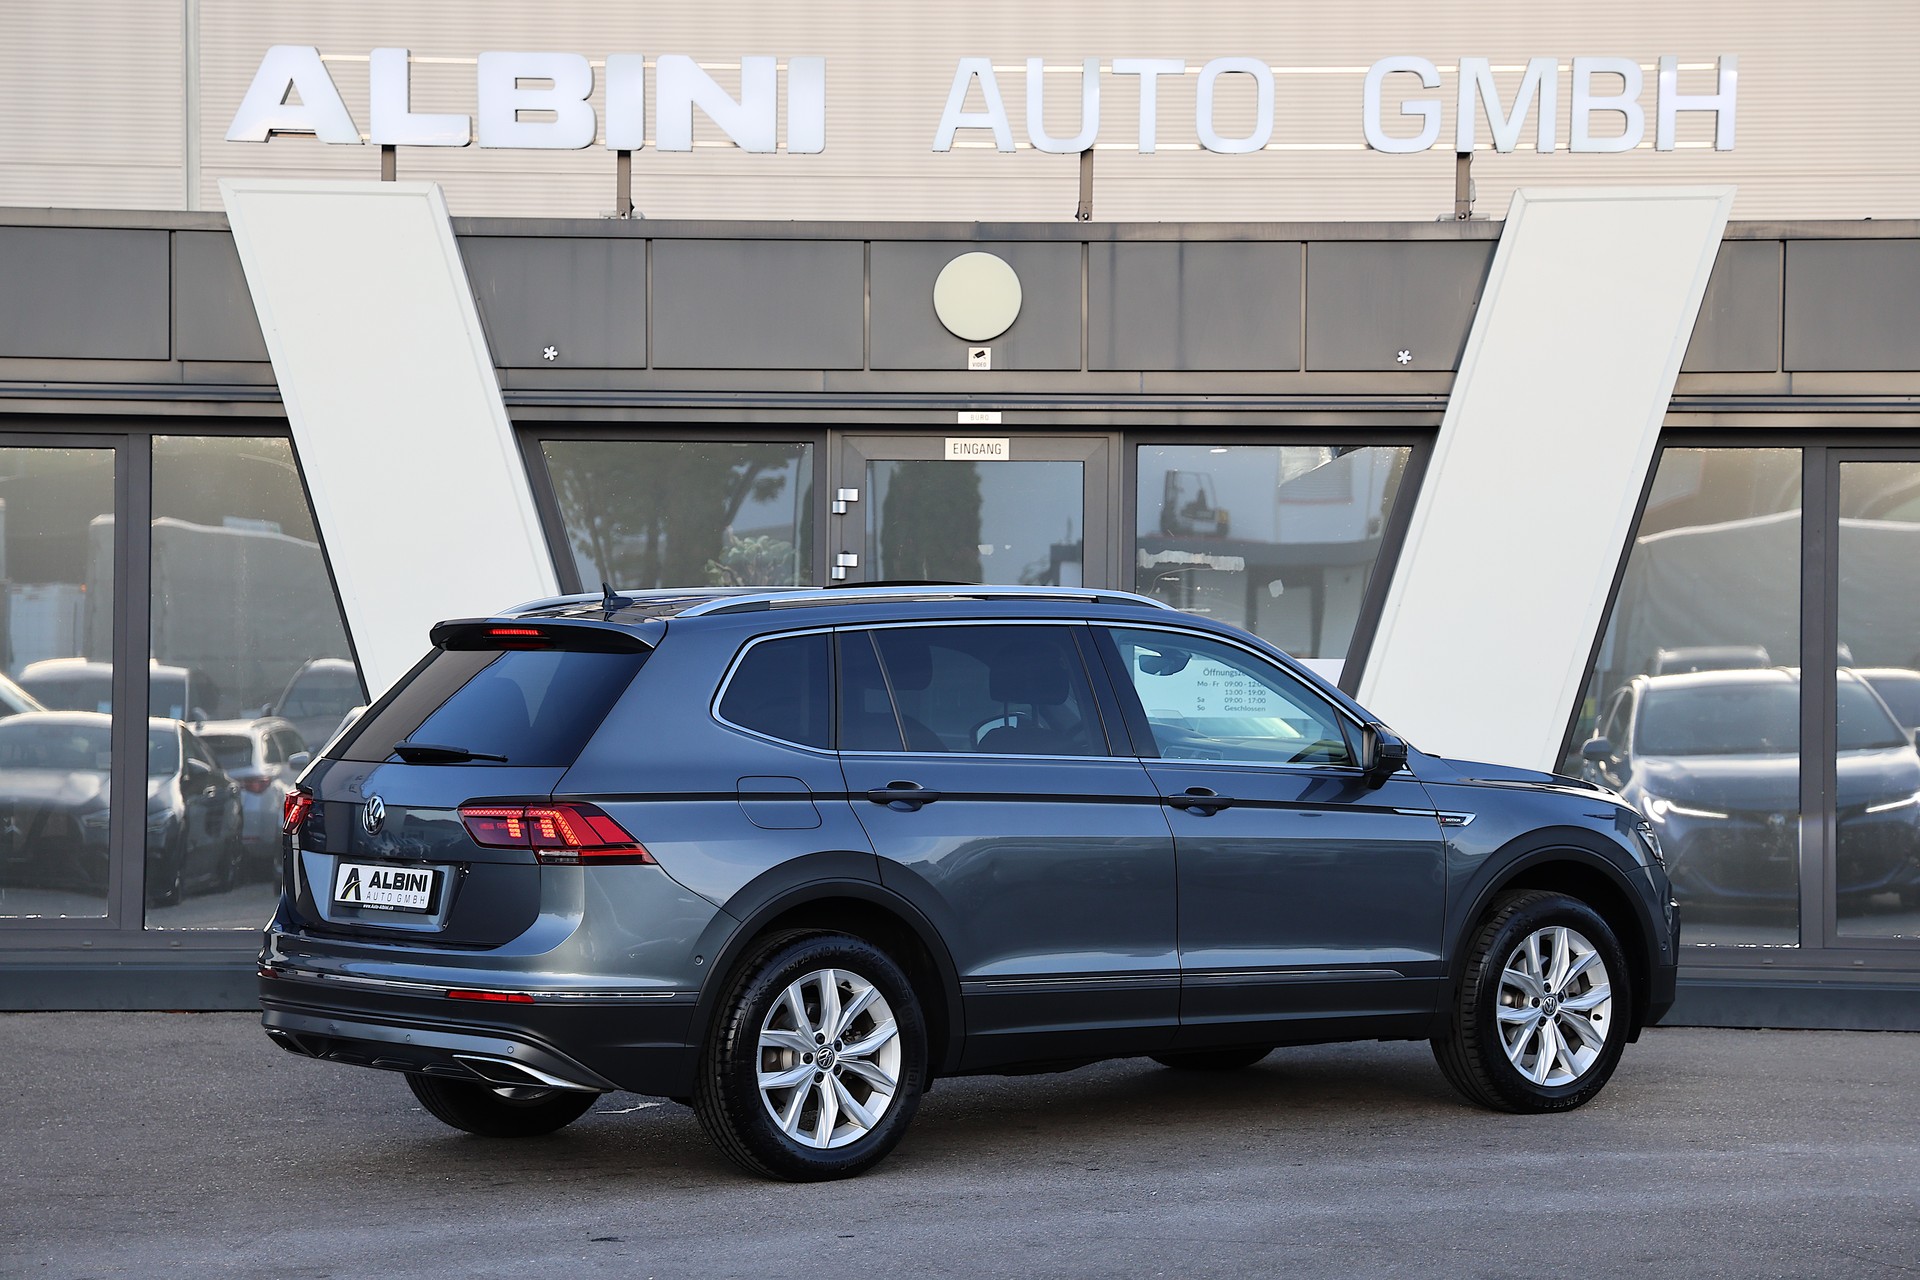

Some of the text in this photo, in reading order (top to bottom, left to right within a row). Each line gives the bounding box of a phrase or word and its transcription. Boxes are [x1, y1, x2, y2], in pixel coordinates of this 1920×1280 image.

[224, 44, 1739, 155] ALBINI AUTO GMBH
[953, 443, 1002, 455] EINGANG
[368, 871, 429, 892] ALBINI
[366, 891, 426, 905] AUTO GMBH
